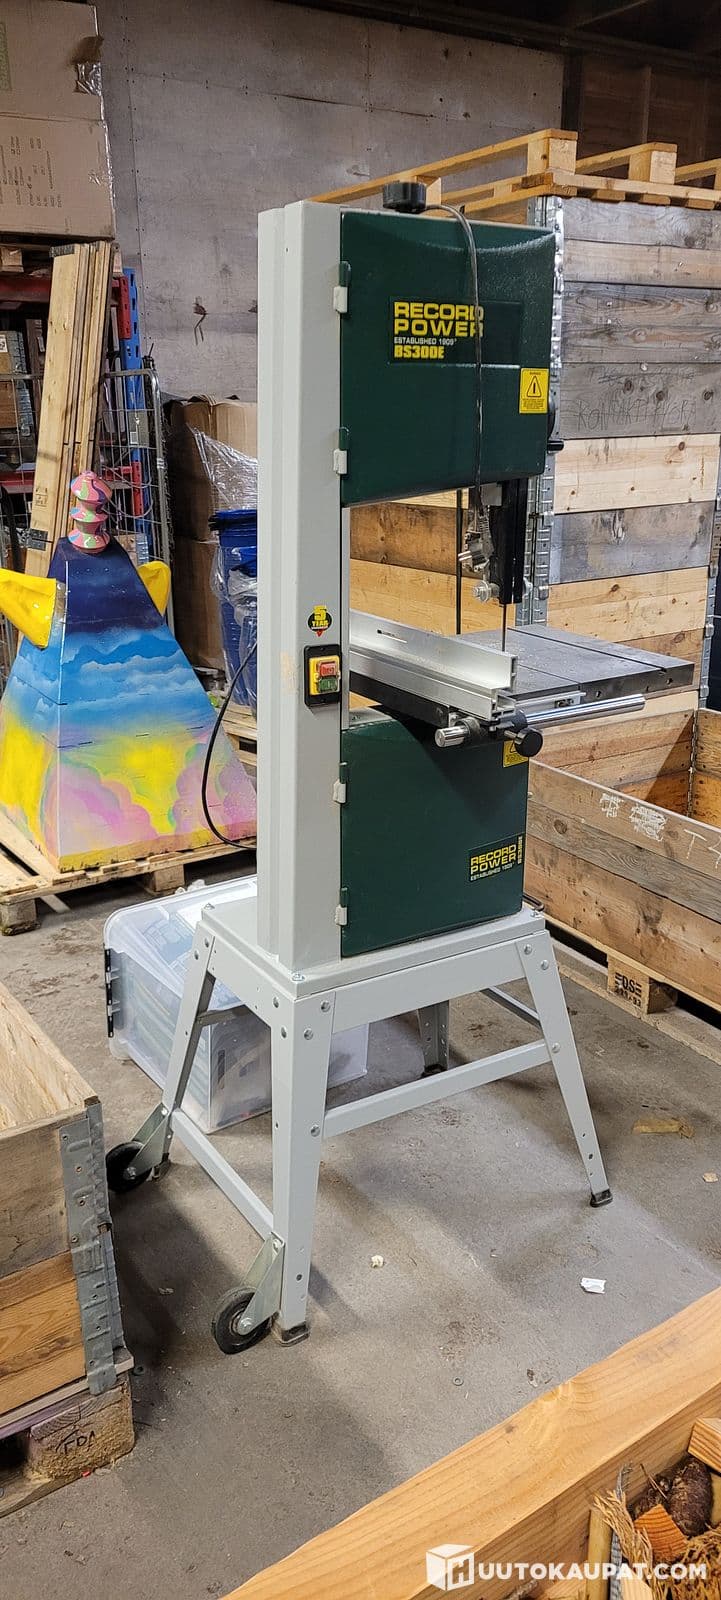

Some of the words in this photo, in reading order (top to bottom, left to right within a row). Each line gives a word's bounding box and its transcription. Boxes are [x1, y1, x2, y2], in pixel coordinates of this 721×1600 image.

[394, 301, 485, 321] RECORD
[394, 318, 484, 337] POWER
[394, 336, 437, 345] ESTABLISHED
[394, 345, 445, 359] BS300E
[470, 844, 517, 866] RECORD
[470, 852, 517, 875] POWER
